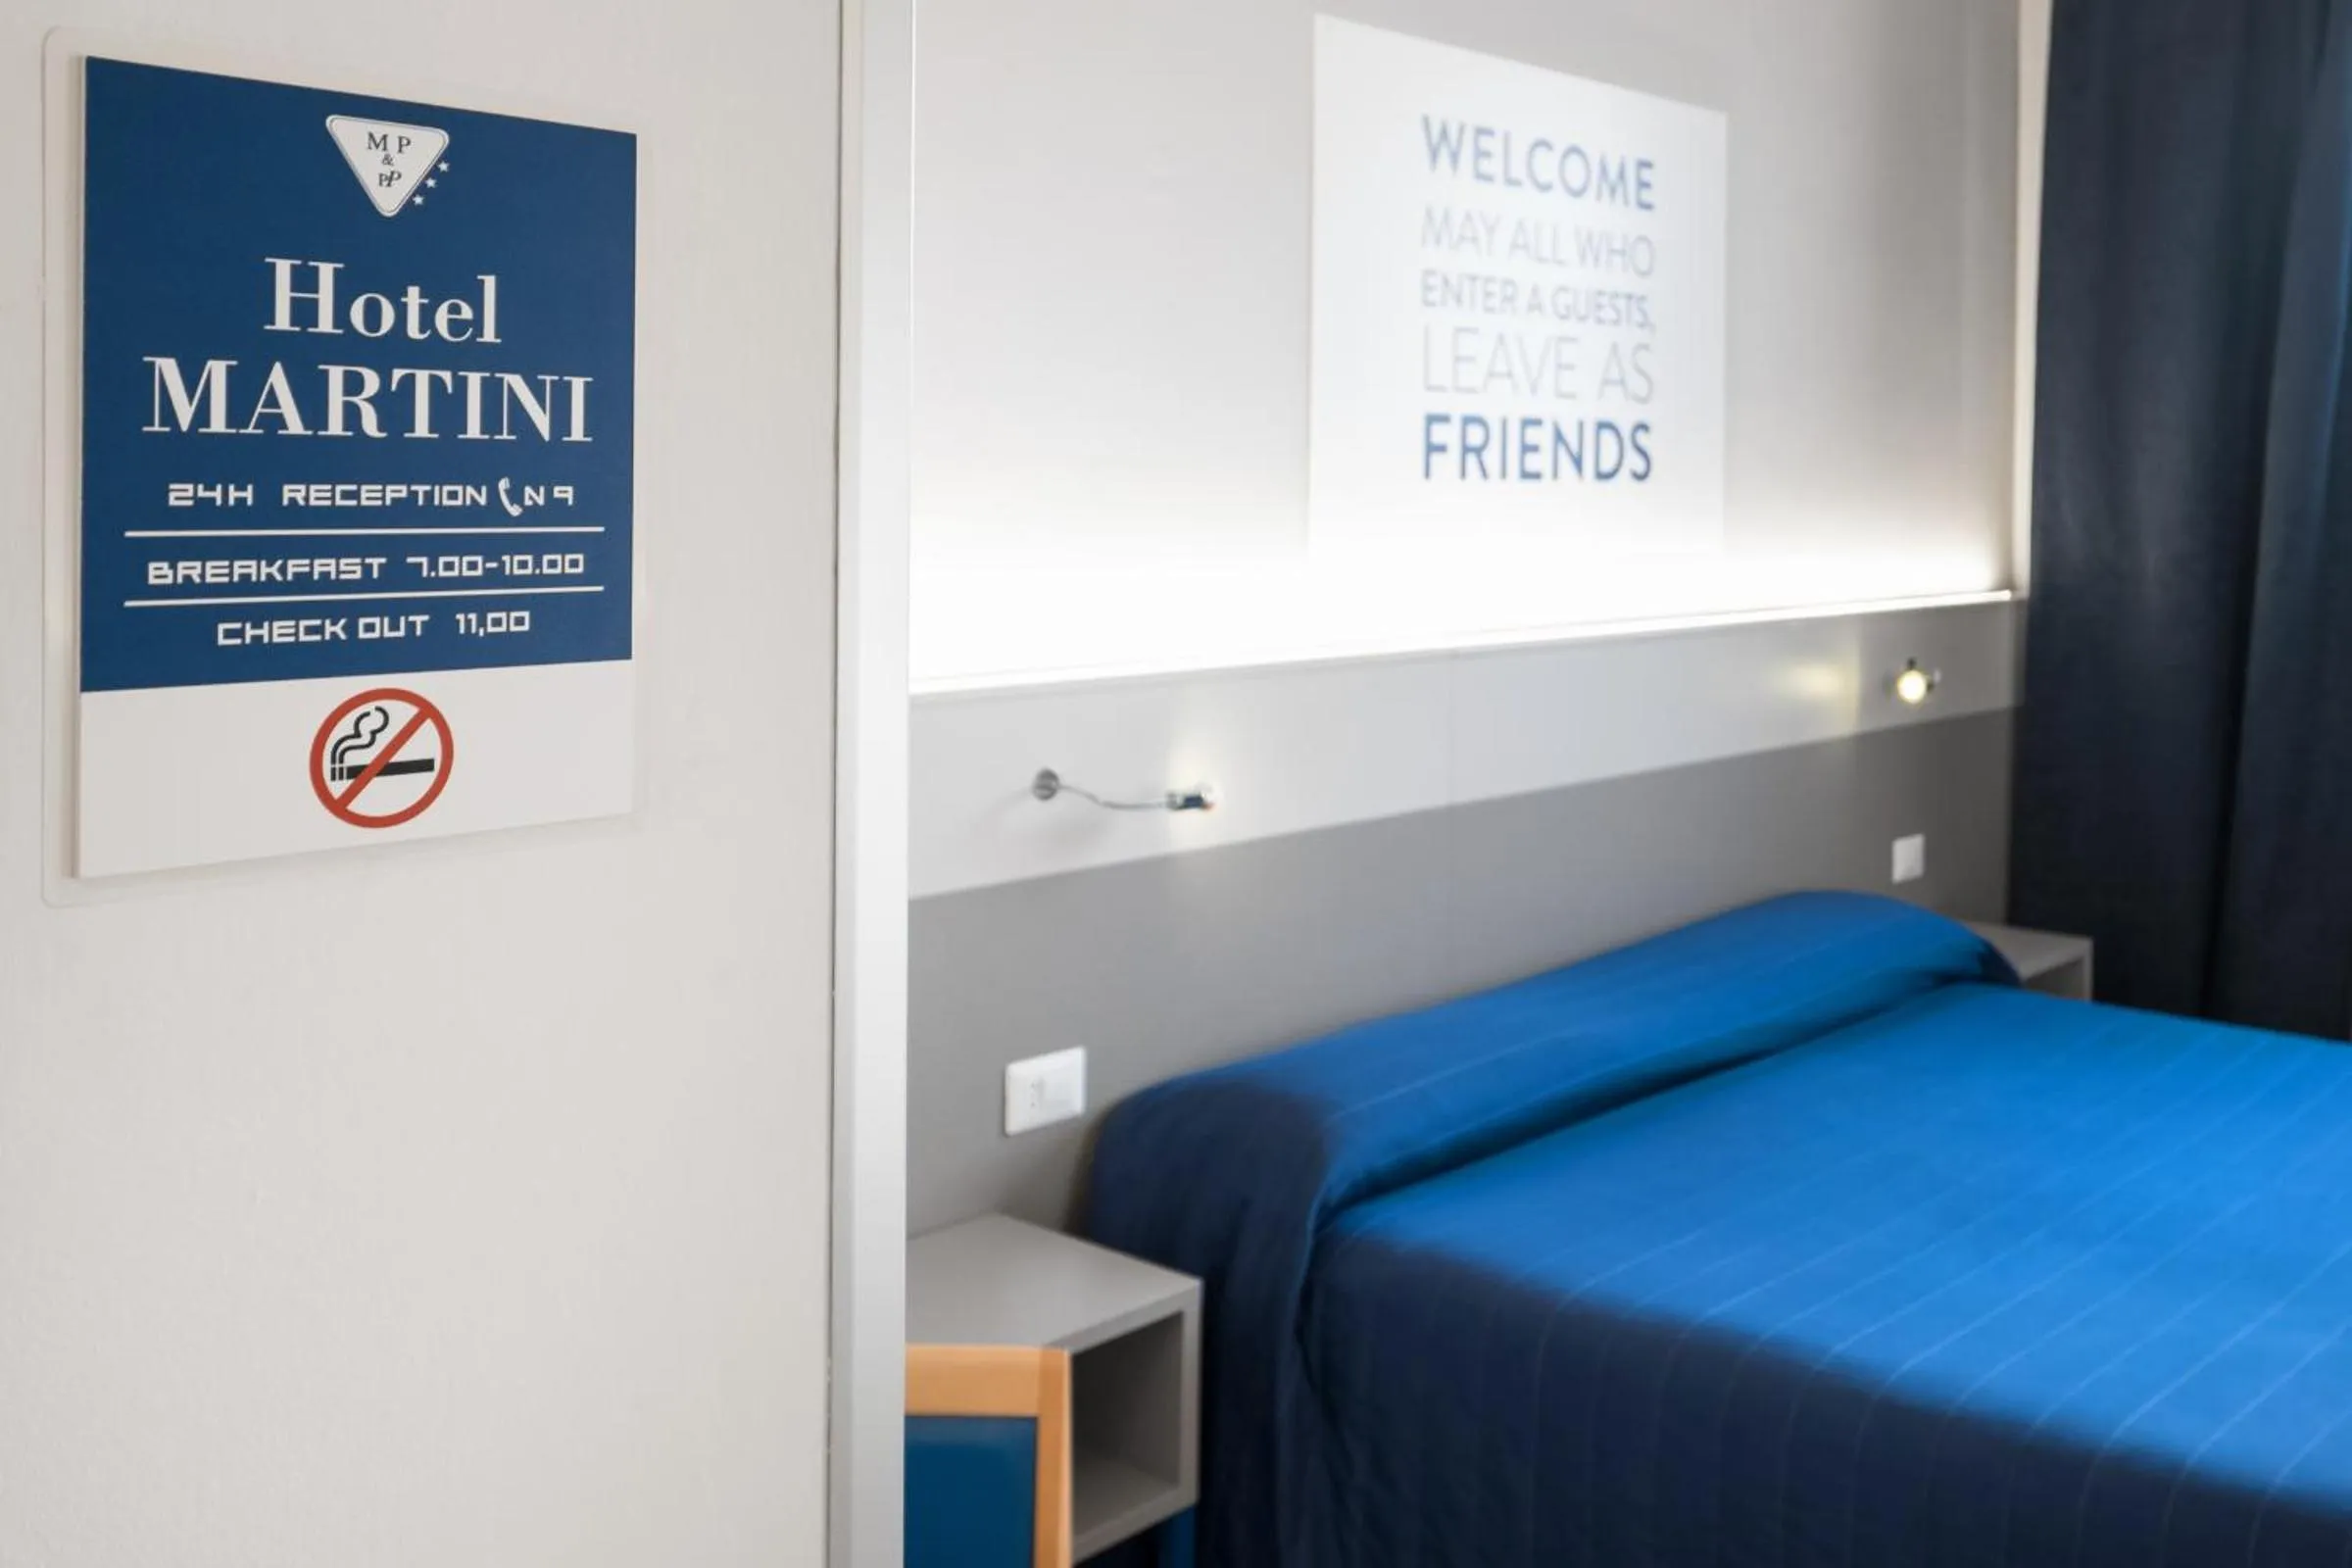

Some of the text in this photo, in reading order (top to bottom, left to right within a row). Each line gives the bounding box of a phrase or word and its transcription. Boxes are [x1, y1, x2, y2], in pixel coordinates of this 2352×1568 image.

[1422, 113, 1655, 212] WELCOME
[1421, 203, 1656, 279] MAY ALL WHO
[264, 257, 502, 343] Hotel
[1421, 269, 1519, 316] ENTER
[142, 356, 593, 442] MARTINI
[1423, 323, 1654, 405] LEAVE AS
[1423, 413, 1652, 483] FRIENDS
[168, 483, 254, 507] 24H
[282, 483, 487, 507] RECEPTION
[147, 557, 386, 585] BREAKFAST
[217, 617, 347, 646] CHECK
[358, 614, 430, 639] OUT
